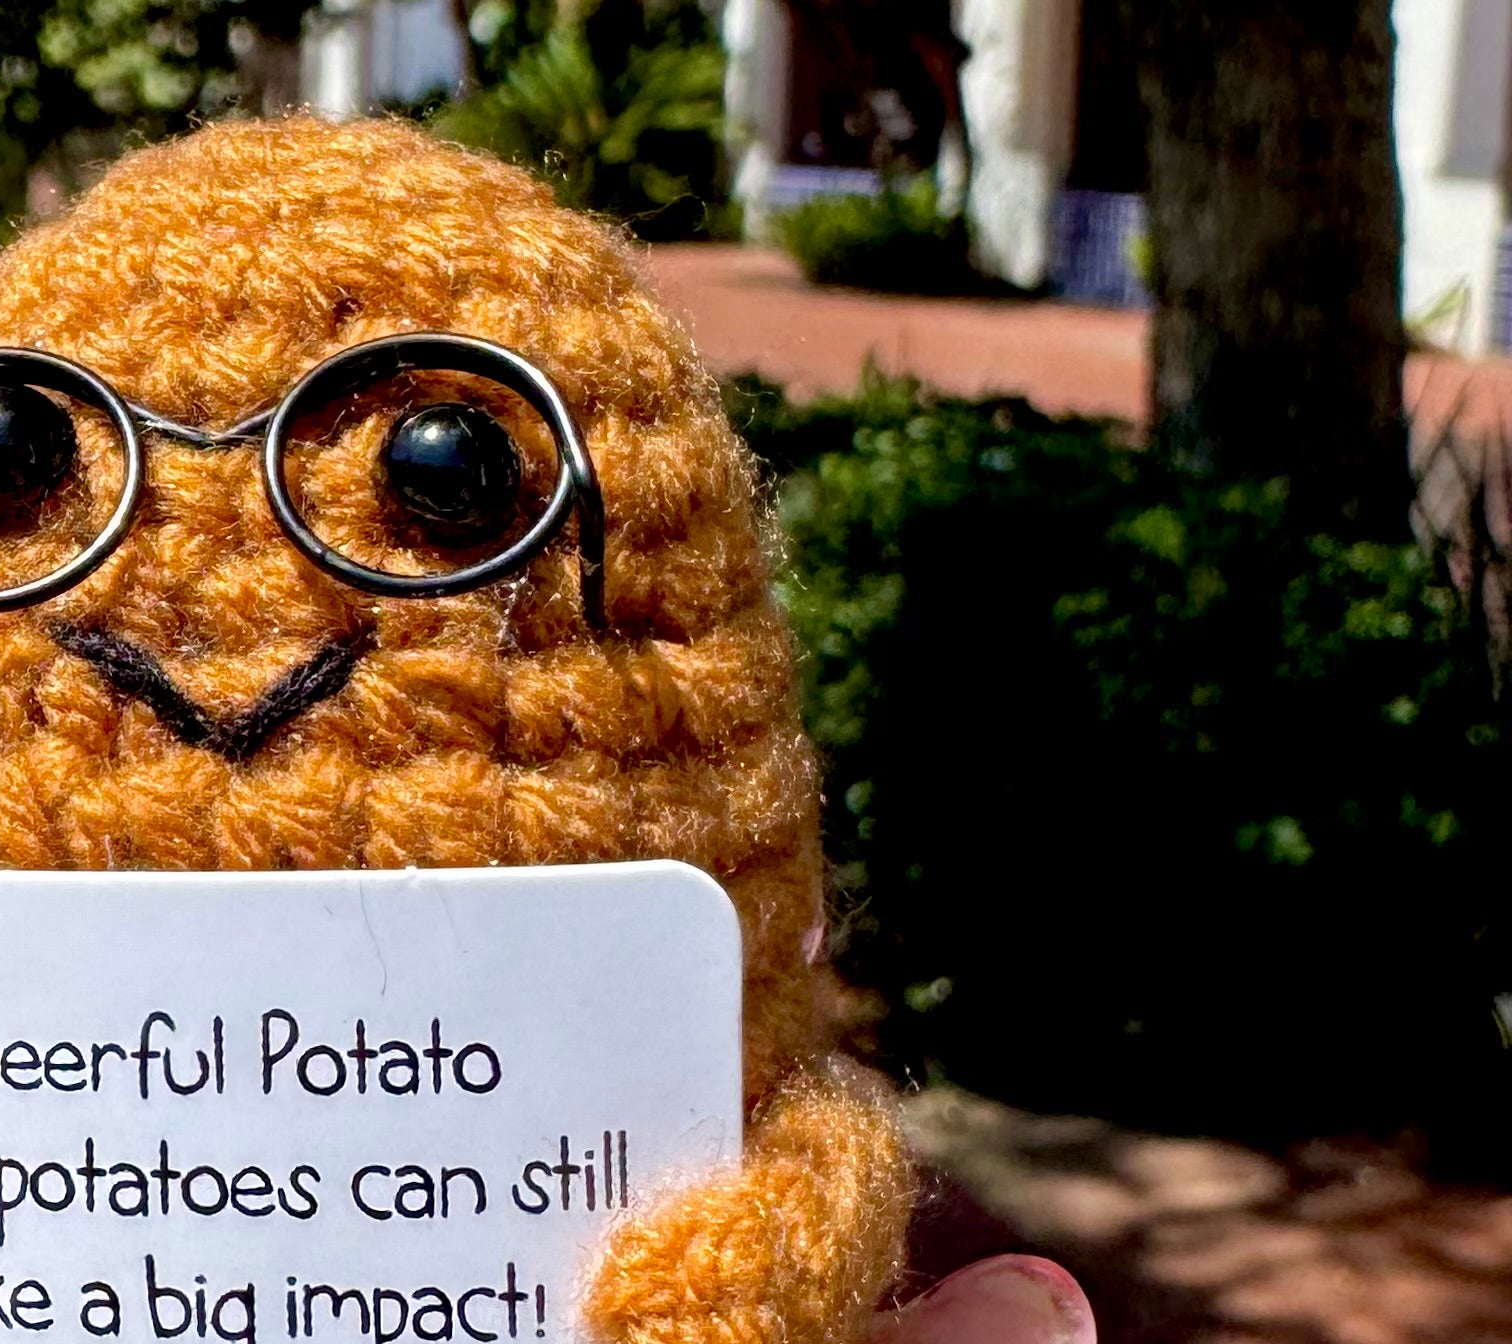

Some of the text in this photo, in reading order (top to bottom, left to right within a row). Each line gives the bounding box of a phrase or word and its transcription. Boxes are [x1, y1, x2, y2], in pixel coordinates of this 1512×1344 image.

[261, 1008, 502, 1097] Potato
[350, 1163, 487, 1221] can
[511, 1130, 629, 1215] still
[80, 1281, 121, 1337] a
